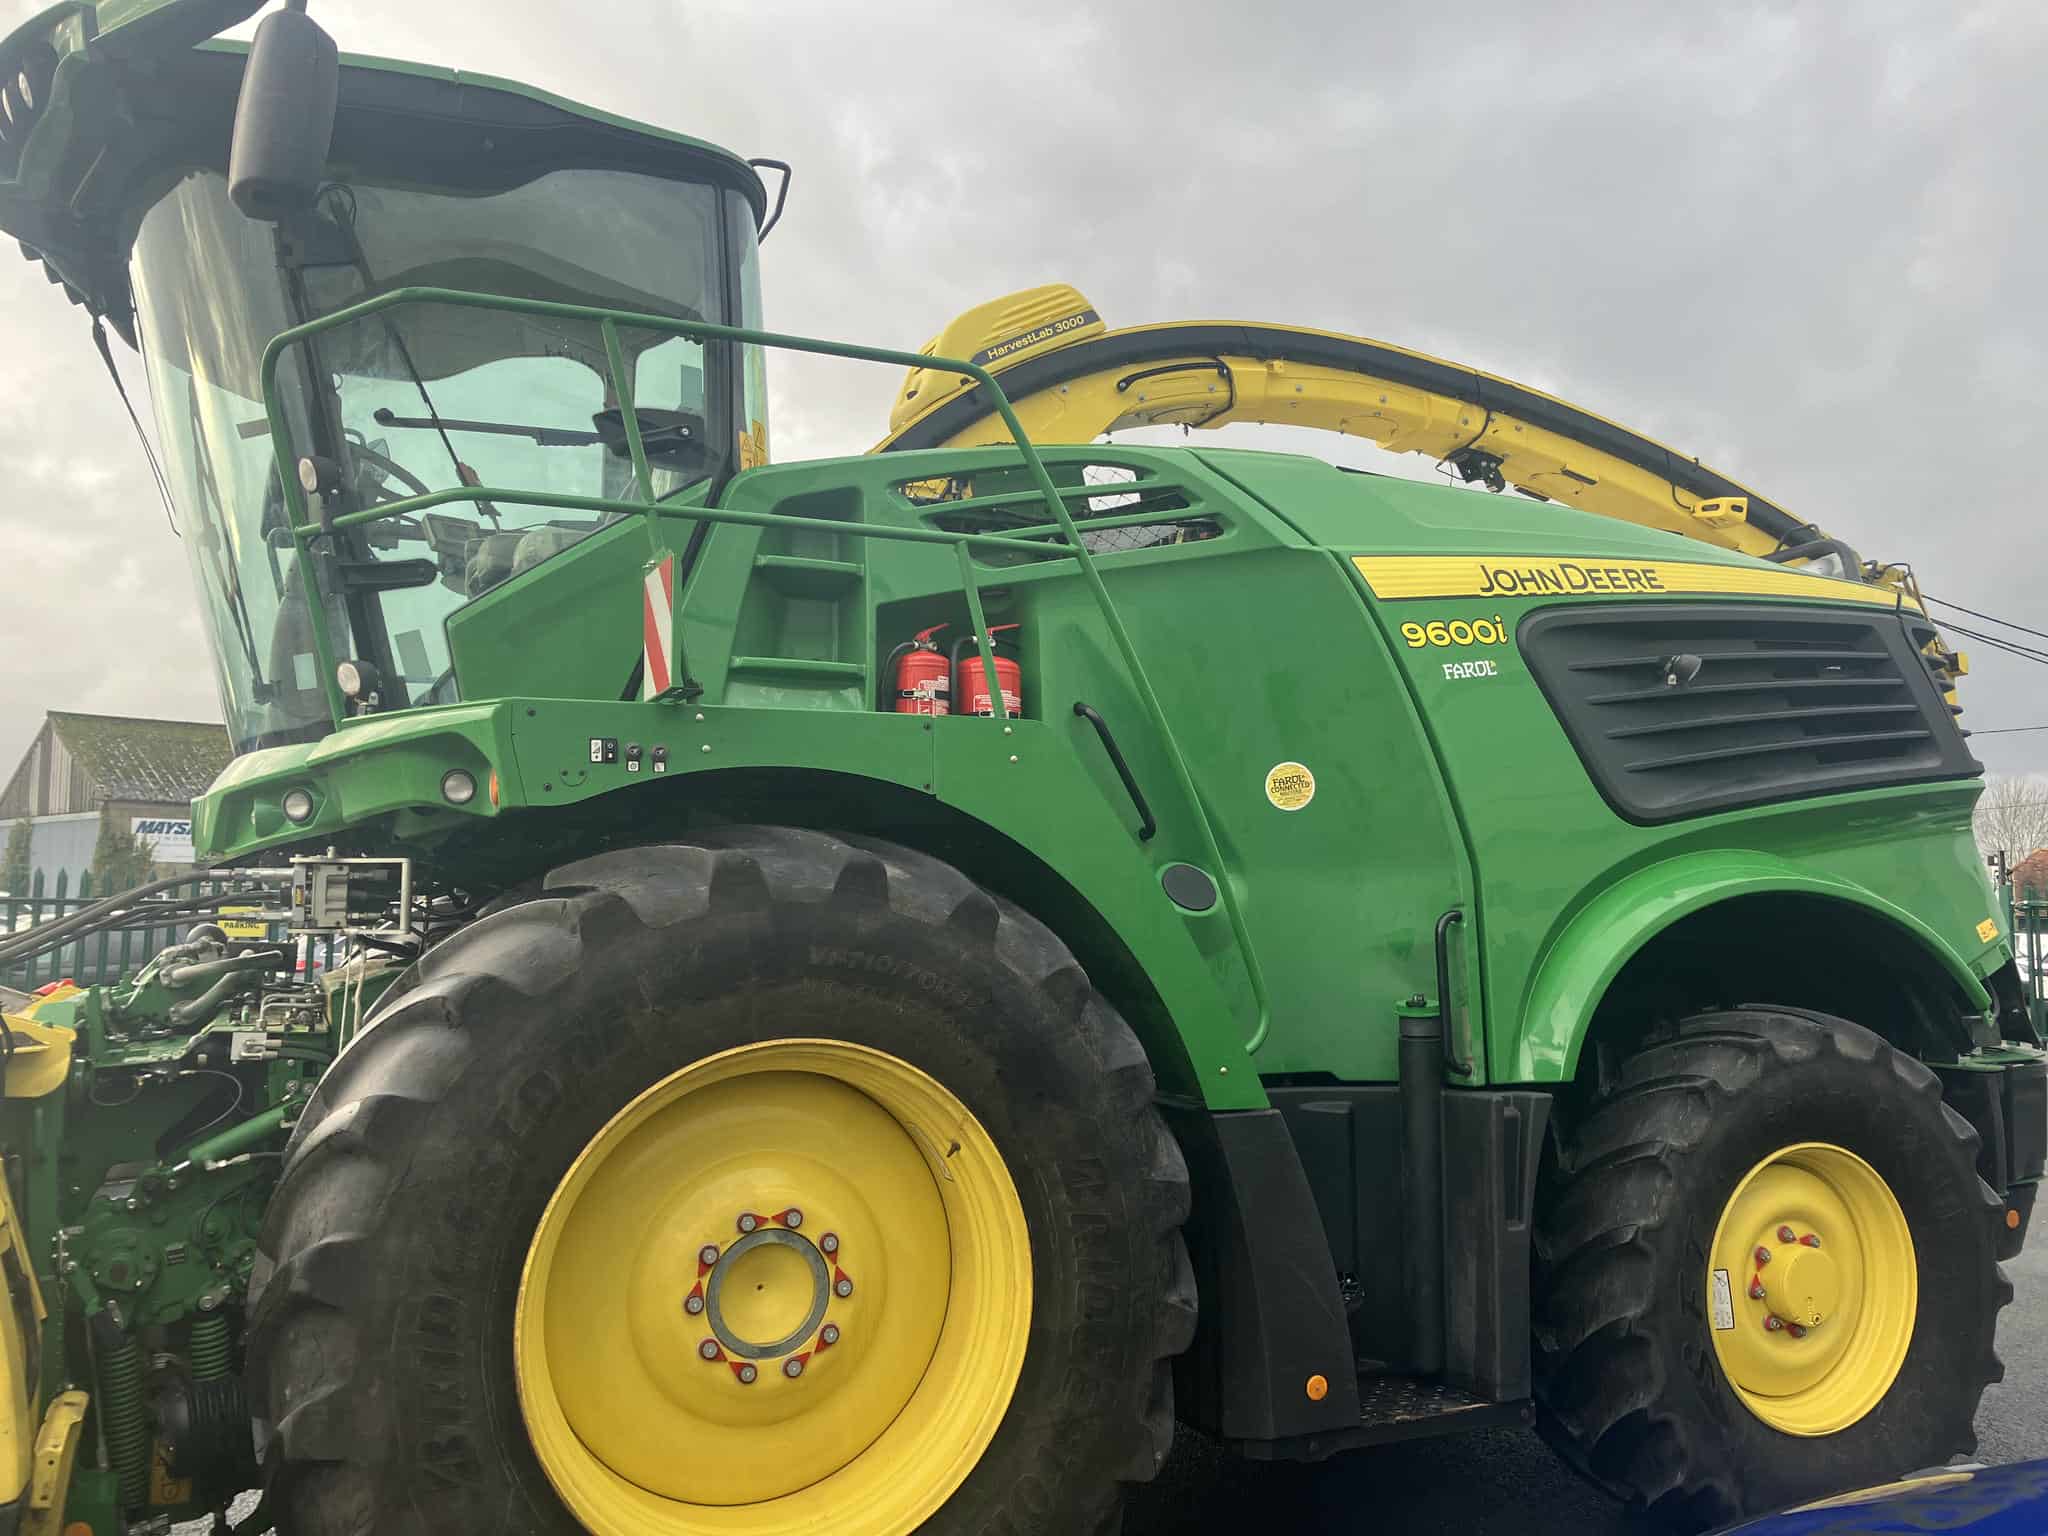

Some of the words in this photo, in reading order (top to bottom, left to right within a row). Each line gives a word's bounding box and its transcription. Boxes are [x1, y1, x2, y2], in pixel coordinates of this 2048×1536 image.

[986, 326, 1054, 360] HarvestLab
[1054, 314, 1085, 334] 3000
[1479, 564, 1564, 593] JOHN
[1558, 563, 1665, 591] DEERE
[1400, 613, 1509, 648] 9600i
[1442, 660, 1497, 680] FAROL
